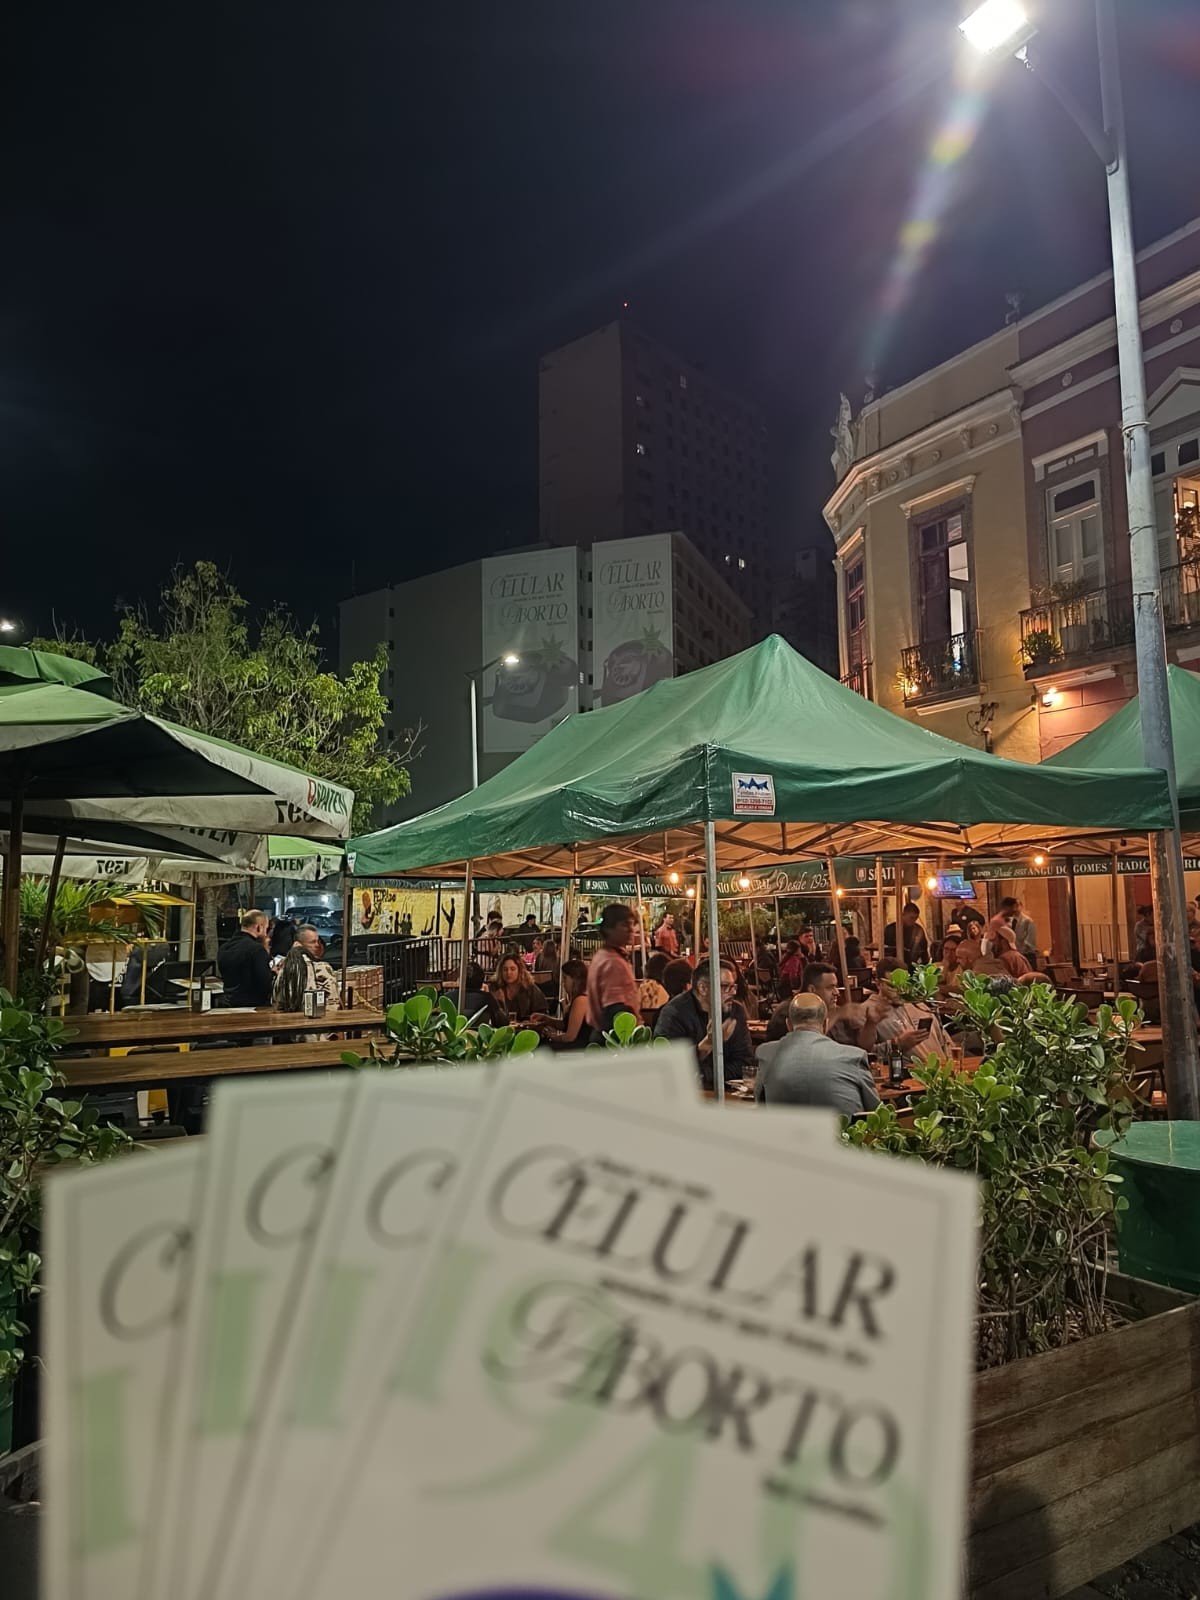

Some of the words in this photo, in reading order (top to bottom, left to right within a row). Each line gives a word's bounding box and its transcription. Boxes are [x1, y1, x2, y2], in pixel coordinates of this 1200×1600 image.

[489, 572, 565, 599] CELULAR
[600, 560, 662, 586] CELULAR
[313, 782, 348, 816] SPATEN
[268, 858, 304, 871] PATEN
[1073, 863, 1108, 873] GOMES
[1110, 861, 1151, 875] RADIÇ
[642, 883, 654, 894] DO
[776, 871, 807, 892] Desde
[810, 873, 831, 889] 195
[486, 1143, 897, 1345] CELULAR
